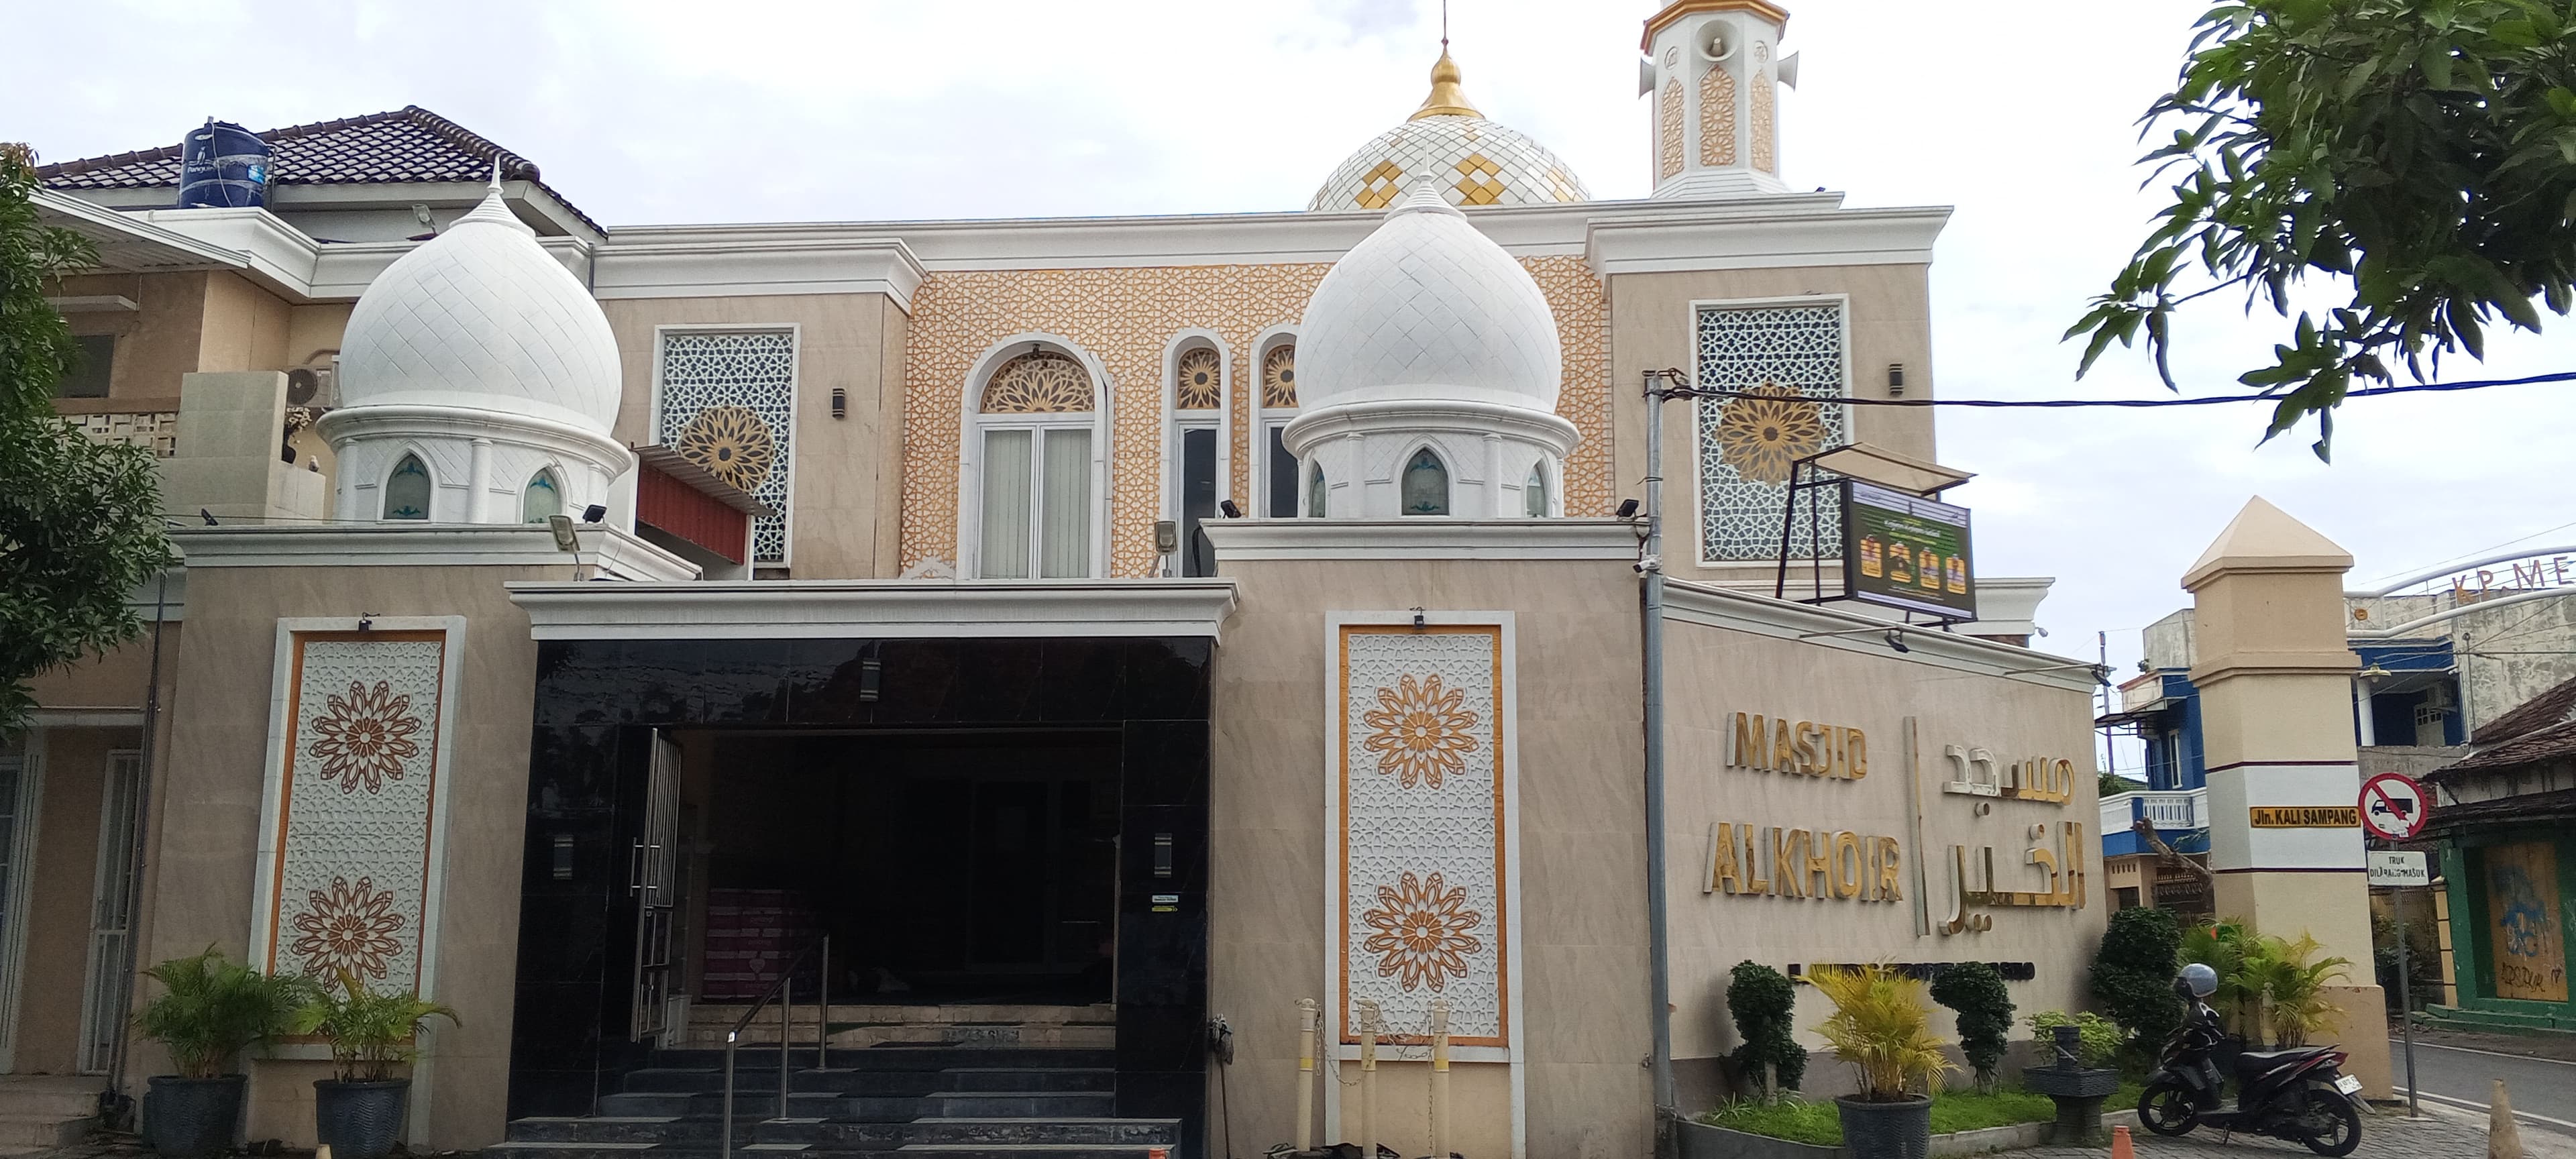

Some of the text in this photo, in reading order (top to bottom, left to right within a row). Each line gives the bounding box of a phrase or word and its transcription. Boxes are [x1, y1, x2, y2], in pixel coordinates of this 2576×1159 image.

[1726, 711, 1867, 781] MASJID
[1943, 744, 2075, 816] مسجد
[2255, 809, 2357, 825] Jln. KALI SAMPANG
[1703, 821, 1903, 901] ALKHOIR
[1938, 821, 2086, 935] الخير
[2389, 857, 2404, 865] TRUK
[2402, 868, 2426, 877] MASUK
